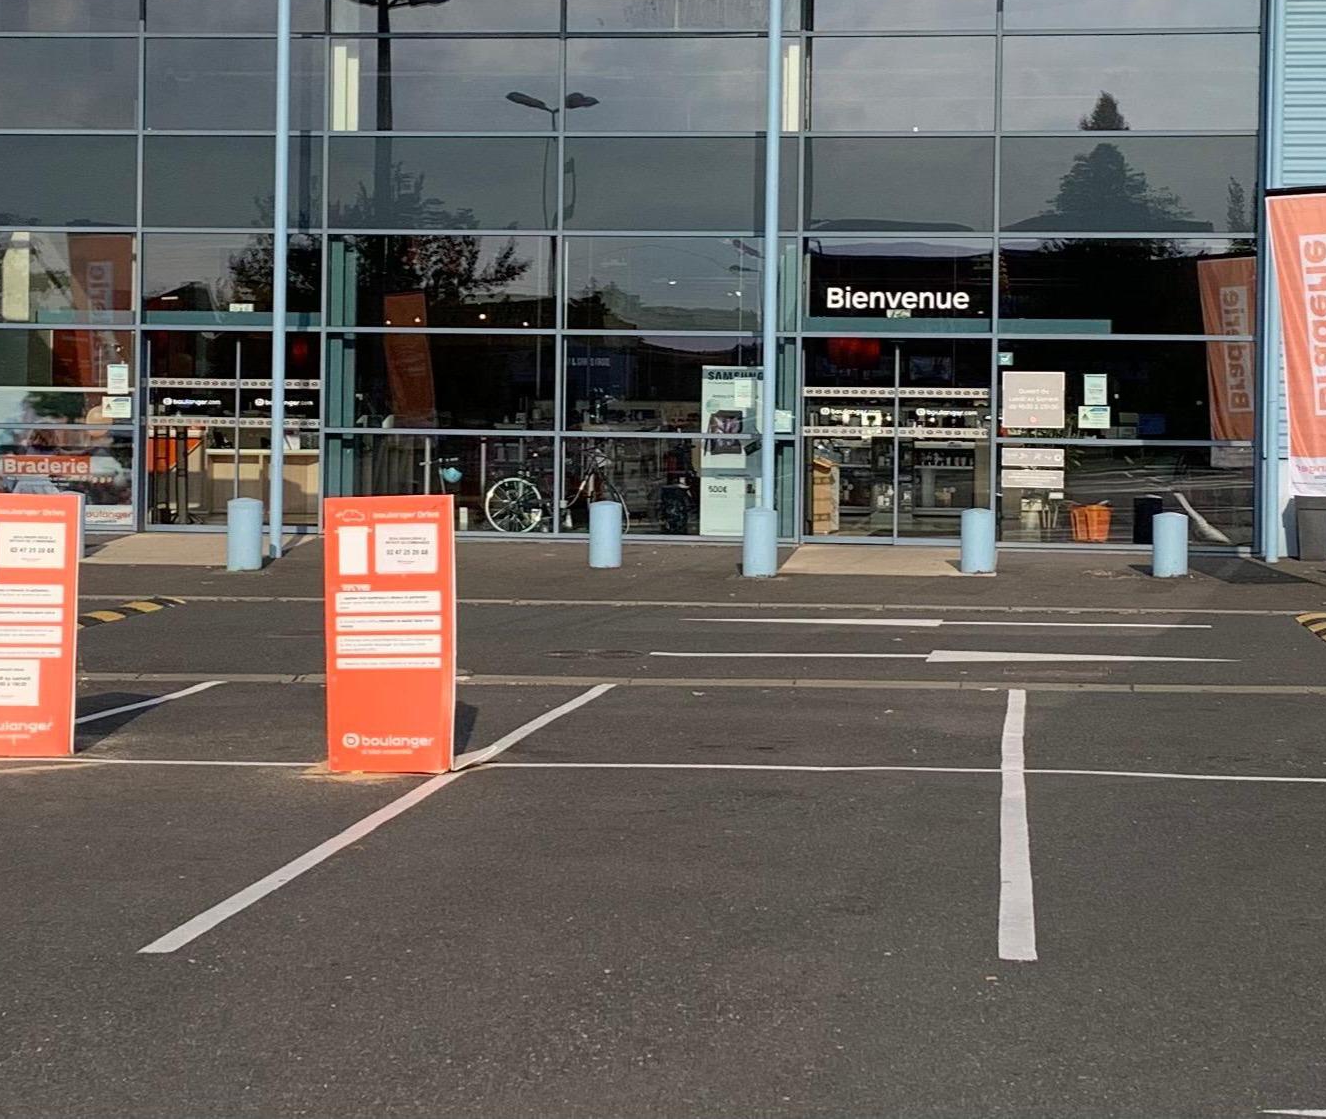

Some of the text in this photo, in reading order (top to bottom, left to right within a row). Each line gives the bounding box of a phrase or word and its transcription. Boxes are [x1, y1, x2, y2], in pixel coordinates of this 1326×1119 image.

[826, 286, 970, 309] Bienvenue
[925, 409, 978, 417] boulanger.com
[3, 458, 89, 473] Braderie
[86, 511, 133, 520] oulanger
[362, 734, 435, 749] boulanger
